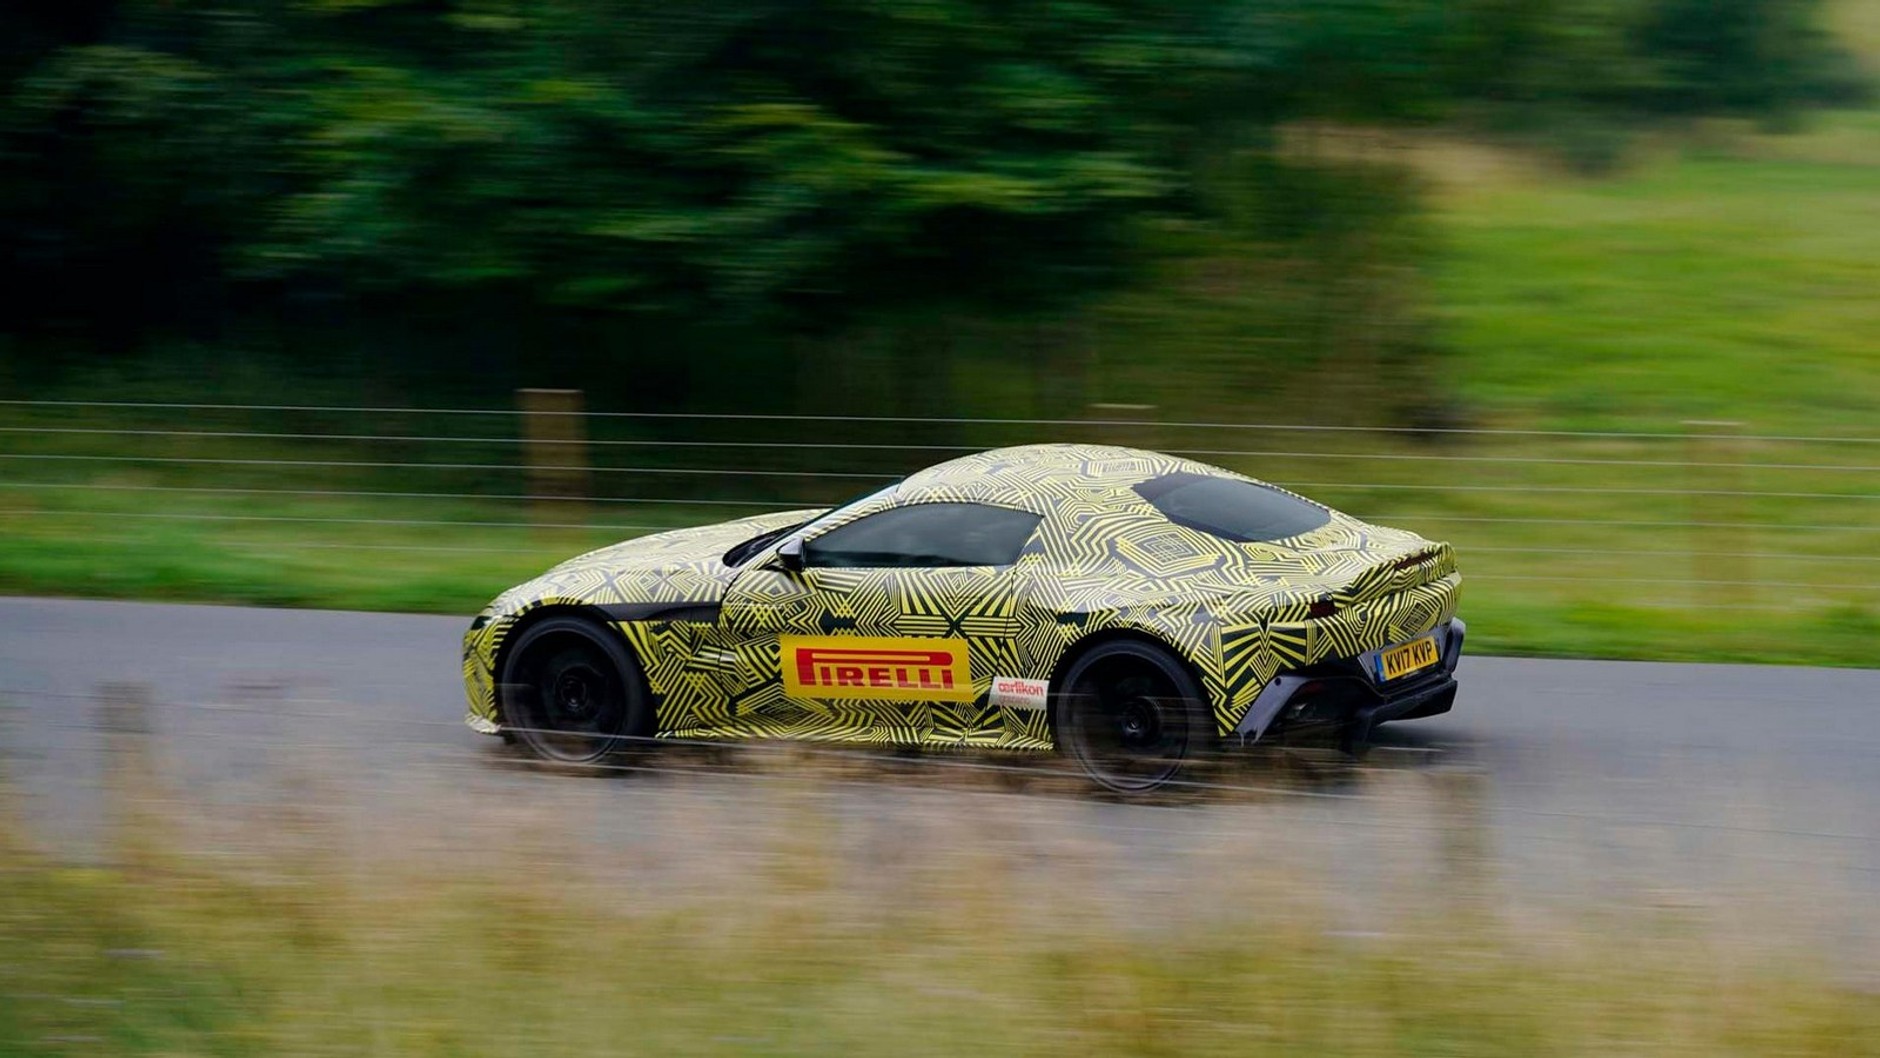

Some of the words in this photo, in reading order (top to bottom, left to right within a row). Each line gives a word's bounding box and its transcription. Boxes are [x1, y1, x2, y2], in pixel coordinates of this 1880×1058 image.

[796, 647, 954, 690] PIRELLI
[1386, 648, 1410, 675] KV17
[1412, 640, 1432, 665] KVP
